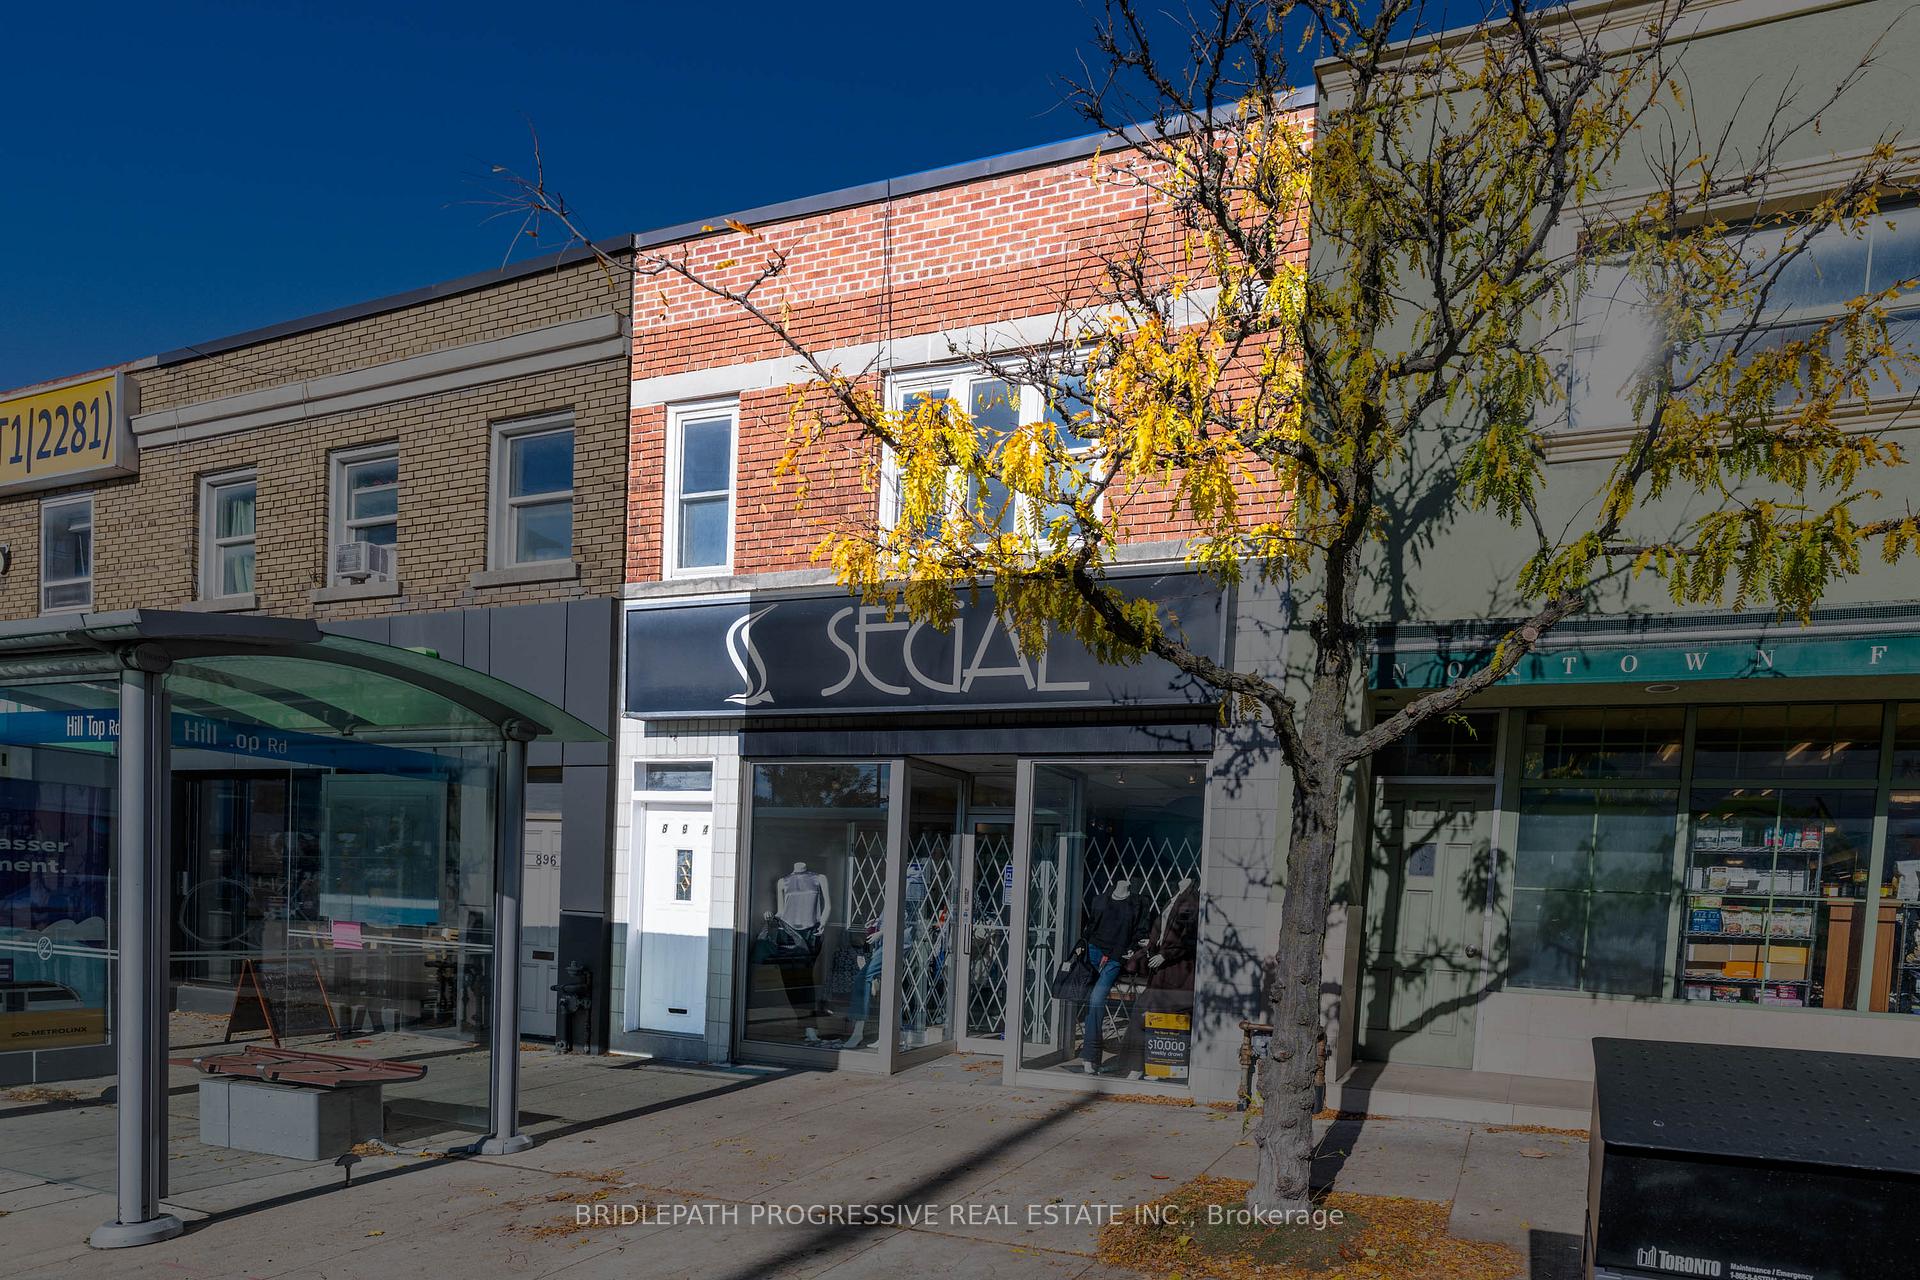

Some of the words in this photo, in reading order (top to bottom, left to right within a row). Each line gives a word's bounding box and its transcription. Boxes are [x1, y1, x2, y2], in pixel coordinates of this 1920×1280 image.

[821, 600, 1090, 697] SEGAL
[67, 715, 84, 737] Hill
[86, 714, 106, 741] Top
[184, 719, 217, 745] Hill
[267, 737, 288, 754] Rd
[661, 823, 709, 836] 894
[536, 854, 557, 867] 896
[31, 1026, 88, 1037] METROLINX
[1148, 1040, 1185, 1051] $10,000
[1659, 1249, 1721, 1278] TORONTO
[1730, 1262, 1771, 1275] Maintenance
[1776, 1269, 1814, 1280] Emergency
